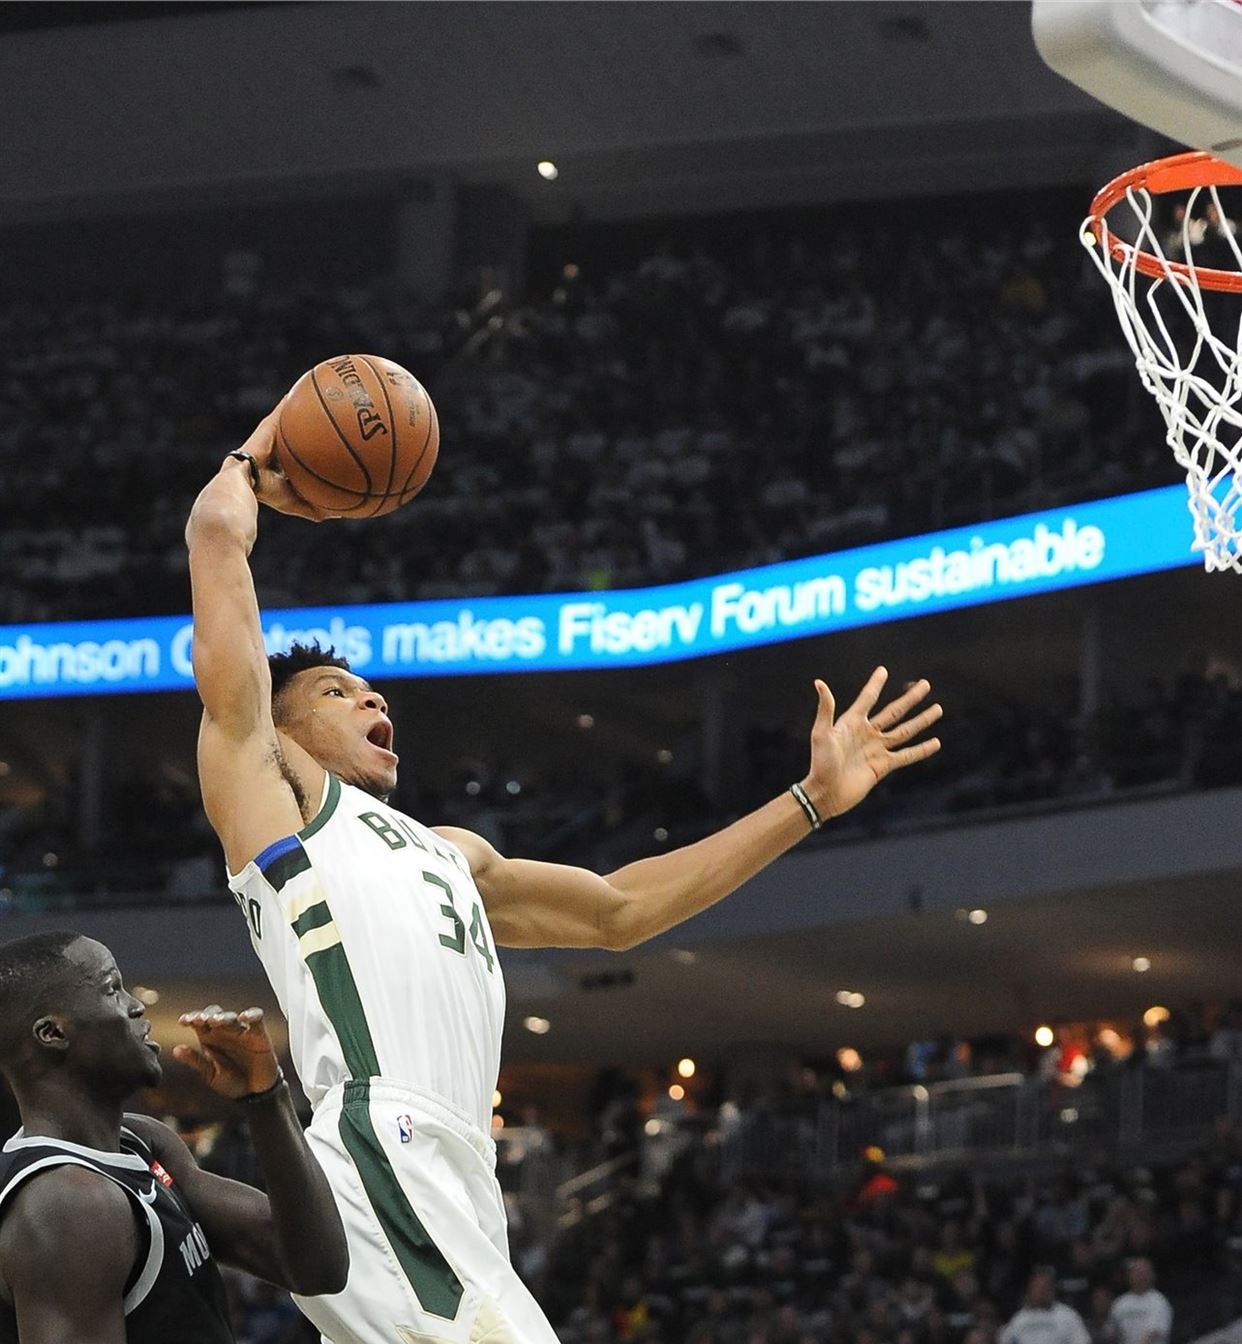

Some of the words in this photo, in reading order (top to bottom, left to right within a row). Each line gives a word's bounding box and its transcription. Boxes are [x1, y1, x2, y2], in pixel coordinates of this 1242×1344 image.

[382, 609, 547, 664] makes
[559, 602, 704, 656] Fiserv
[710, 575, 846, 638] Forum
[854, 517, 1106, 611] sustainable
[422, 870, 495, 974] 34
